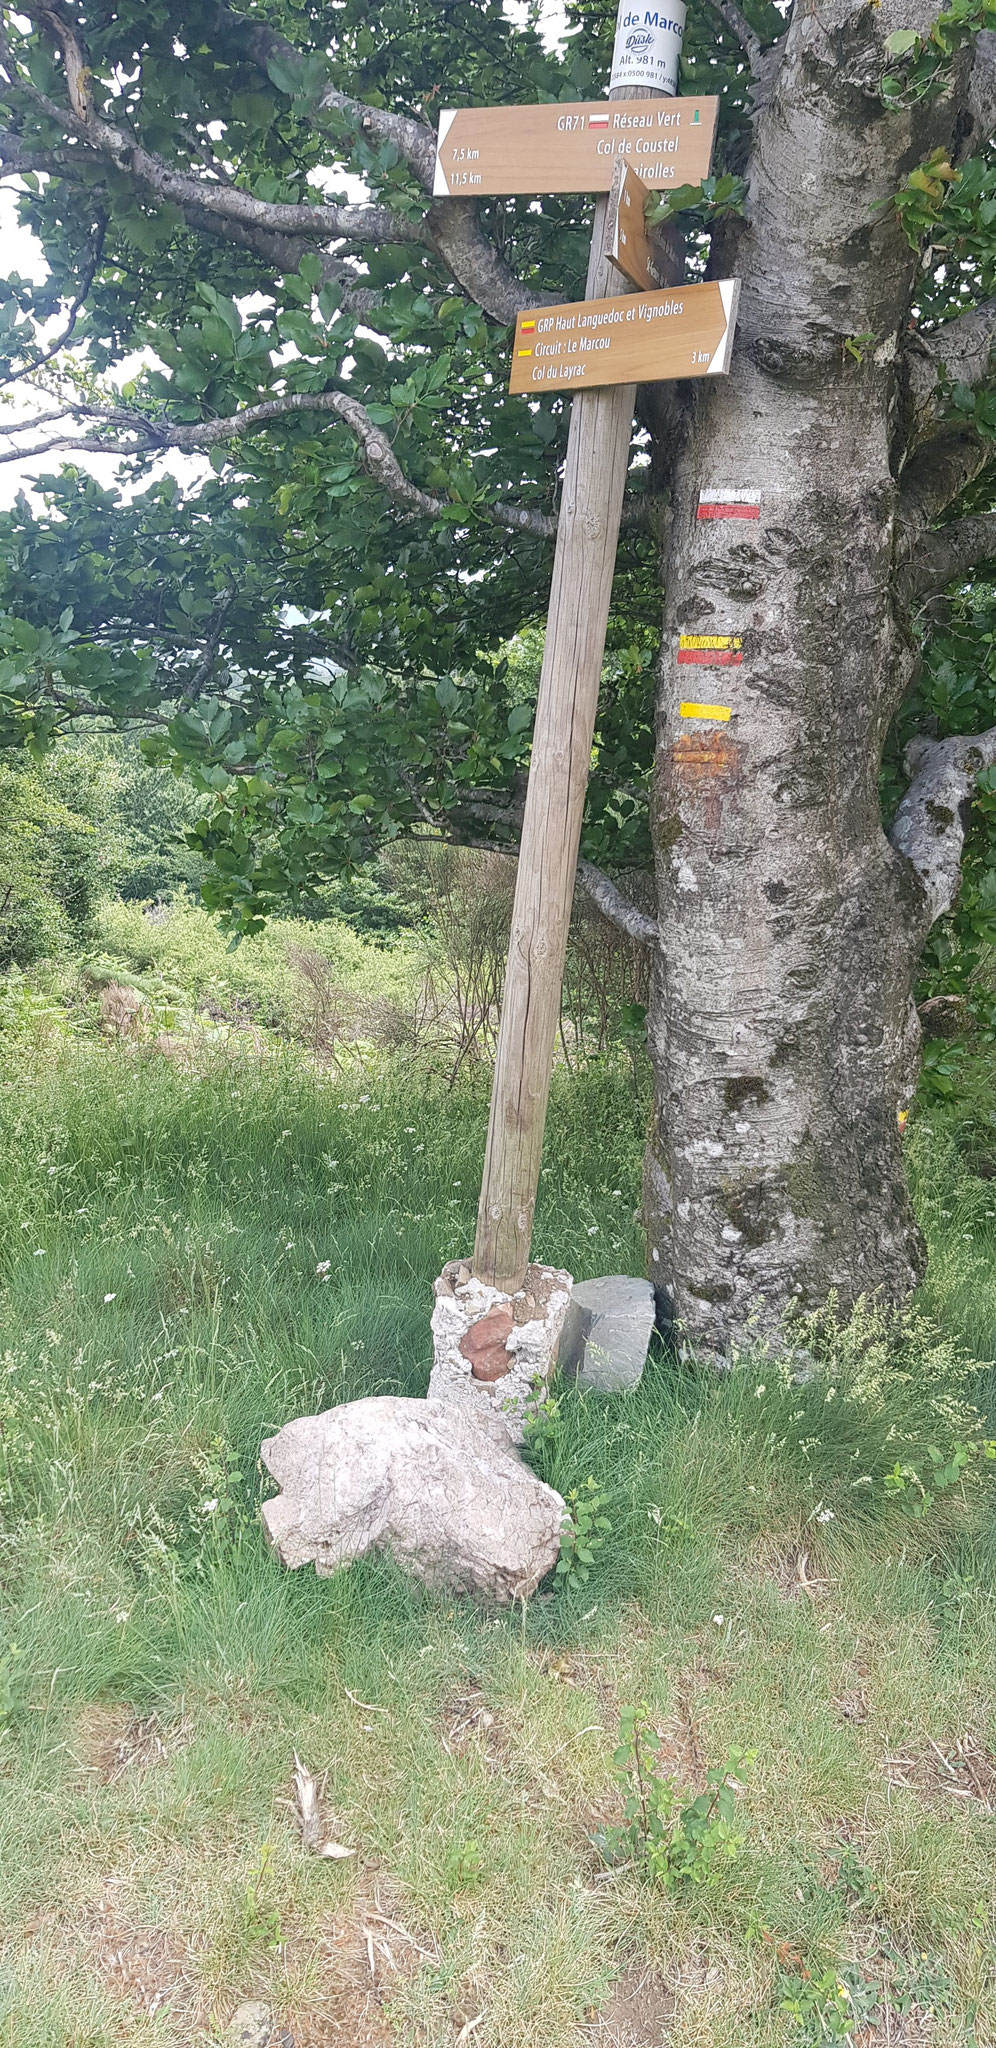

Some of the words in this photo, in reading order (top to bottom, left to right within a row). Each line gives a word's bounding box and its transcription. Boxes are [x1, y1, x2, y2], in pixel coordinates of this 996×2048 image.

[623, 11, 640, 28] de
[619, 54, 634, 66] Alt.
[636, 54, 654, 66] 981
[656, 59, 666, 69] m
[557, 115, 585, 131] GR71
[613, 113, 653, 128] Réseau
[656, 111, 681, 127] Vert
[597, 138, 615, 155] Col
[618, 138, 632, 154] de
[635, 135, 679, 153] Coustel
[452, 148, 465, 162] 7,5
[466, 147, 480, 160] km
[450, 172, 467, 186] 11,5
[469, 171, 482, 185] km
[633, 162, 674, 178] airolles
[537, 317, 554, 334] GRP
[555, 315, 576, 331] Haut
[577, 307, 624, 329] Languedoc
[626, 308, 636, 321] et
[638, 300, 683, 322] Vignobles
[534, 341, 562, 357] Circuit
[567, 339, 577, 353] Le
[579, 336, 611, 352] Marcou
[691, 351, 697, 364] 3
[697, 349, 710, 363] km
[532, 365, 546, 381] Col
[546, 364, 558, 379] du
[559, 364, 586, 380] Layrac
